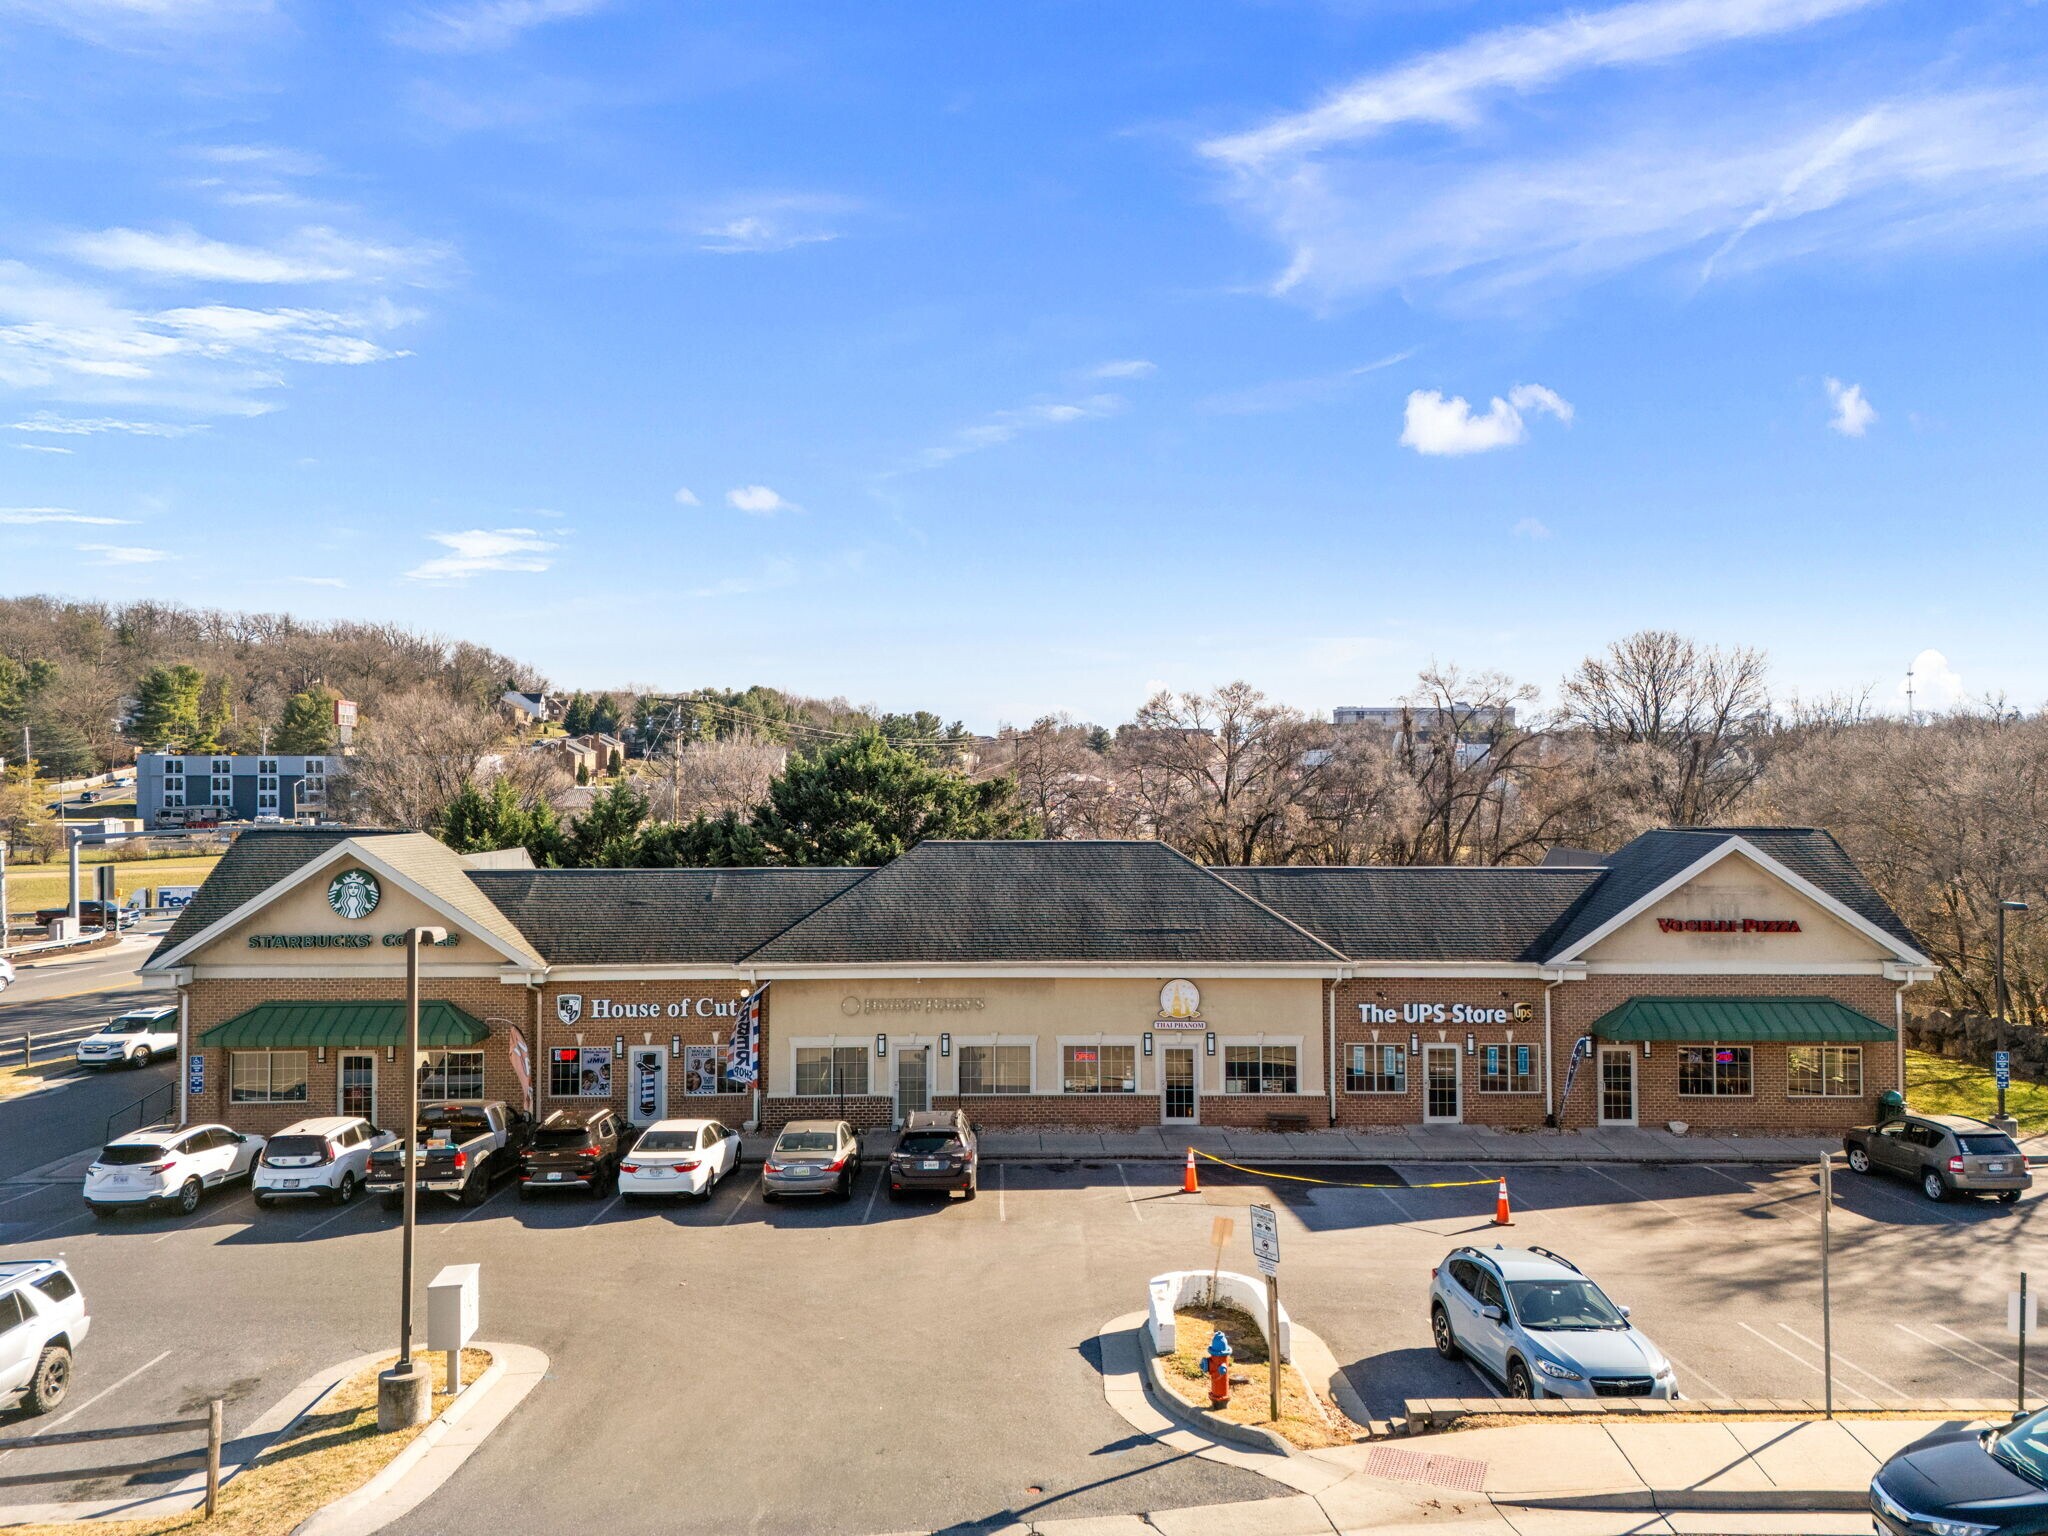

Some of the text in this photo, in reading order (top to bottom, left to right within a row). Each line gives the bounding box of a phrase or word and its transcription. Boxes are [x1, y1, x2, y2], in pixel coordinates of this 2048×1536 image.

[1656, 917, 1802, 933] VOCELLI PIZZA
[248, 934, 372, 949] STARBUCKS
[591, 997, 738, 1018] House of Cut
[1358, 1003, 1508, 1023] The UPS Store
[1515, 1008, 1533, 1022] ups
[1075, 1053, 1097, 1061] OPEN
